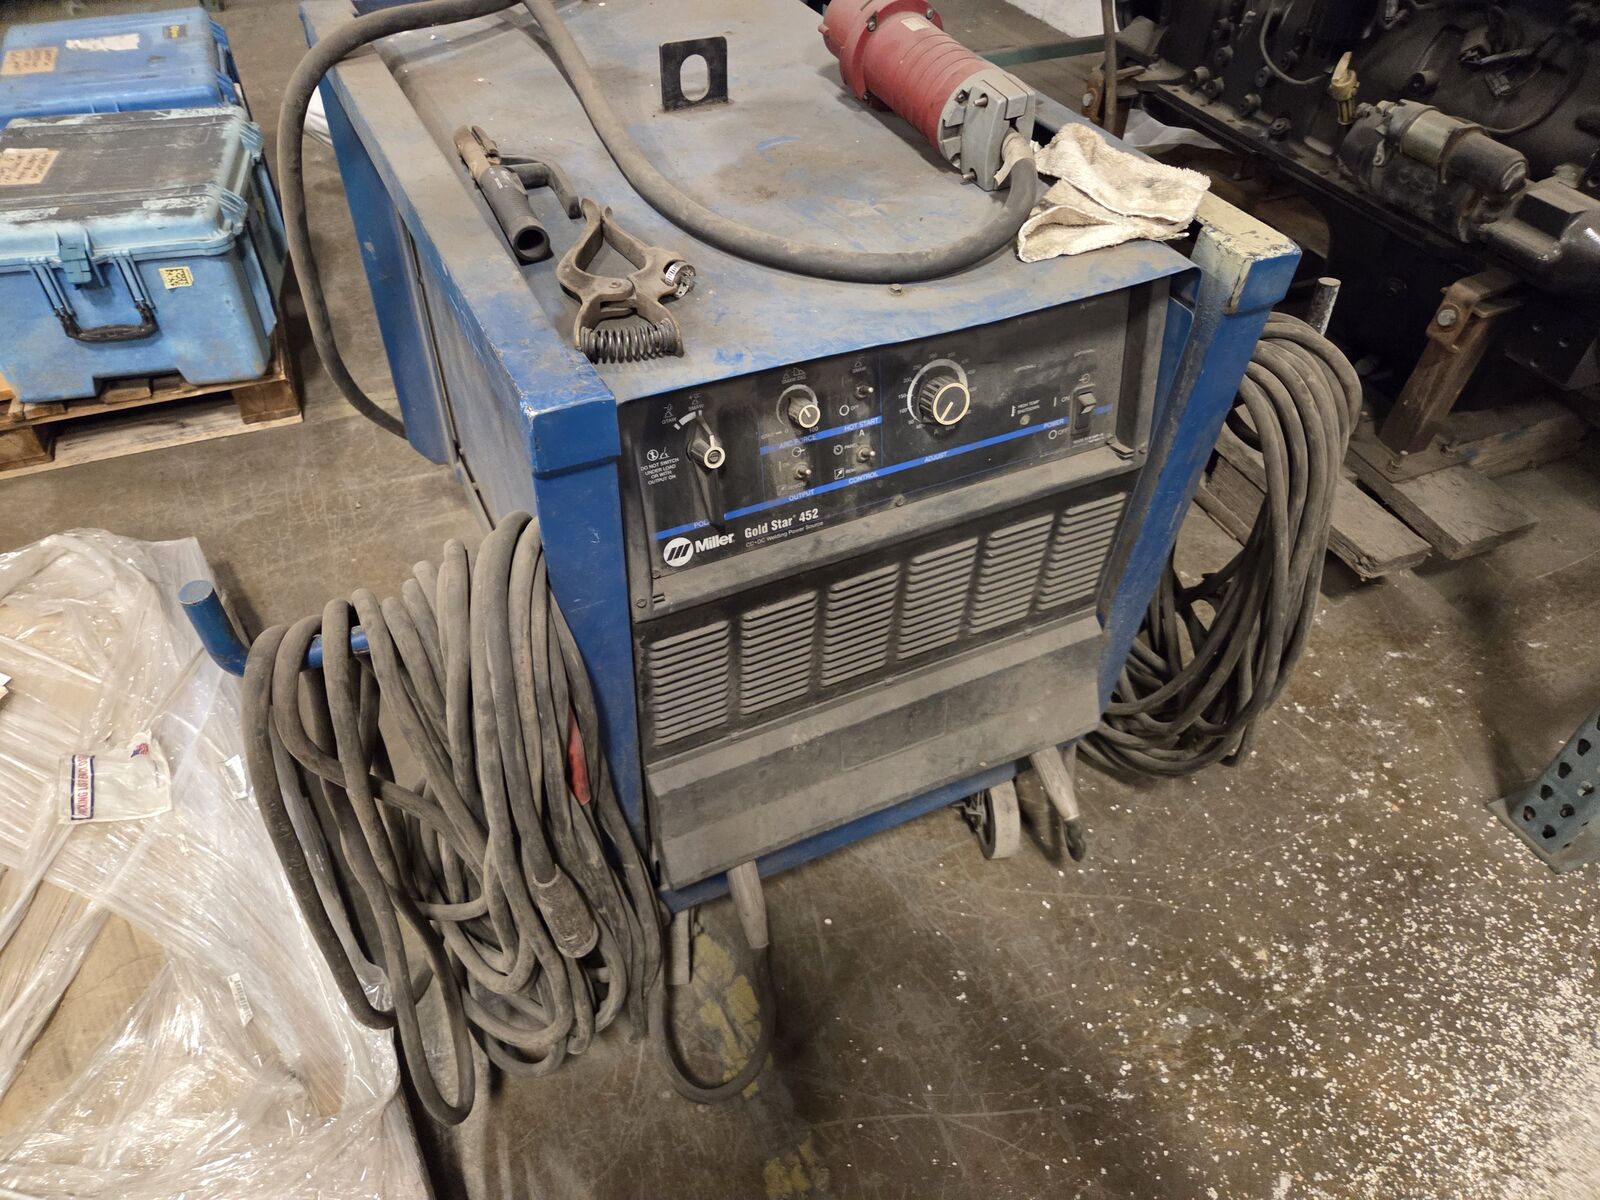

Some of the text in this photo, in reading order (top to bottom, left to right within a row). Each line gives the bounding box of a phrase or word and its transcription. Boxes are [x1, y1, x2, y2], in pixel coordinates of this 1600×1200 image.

[661, 416, 678, 425] GTAW
[844, 417, 880, 431] HOT START
[1043, 418, 1065, 429] POWER
[859, 429, 865, 437] A
[660, 457, 680, 466] SWITCH
[923, 450, 949, 464] ADJUST
[644, 464, 677, 476] UNDER LOAD
[647, 476, 668, 486] OUTPUT
[848, 471, 878, 485] CONTROL
[788, 488, 816, 502] OUTPUT
[744, 507, 819, 539] Gold Star 452
[766, 531, 789, 542] Welding
[788, 527, 805, 539] Power
[804, 520, 824, 531] Source
[694, 532, 734, 554] Miller
